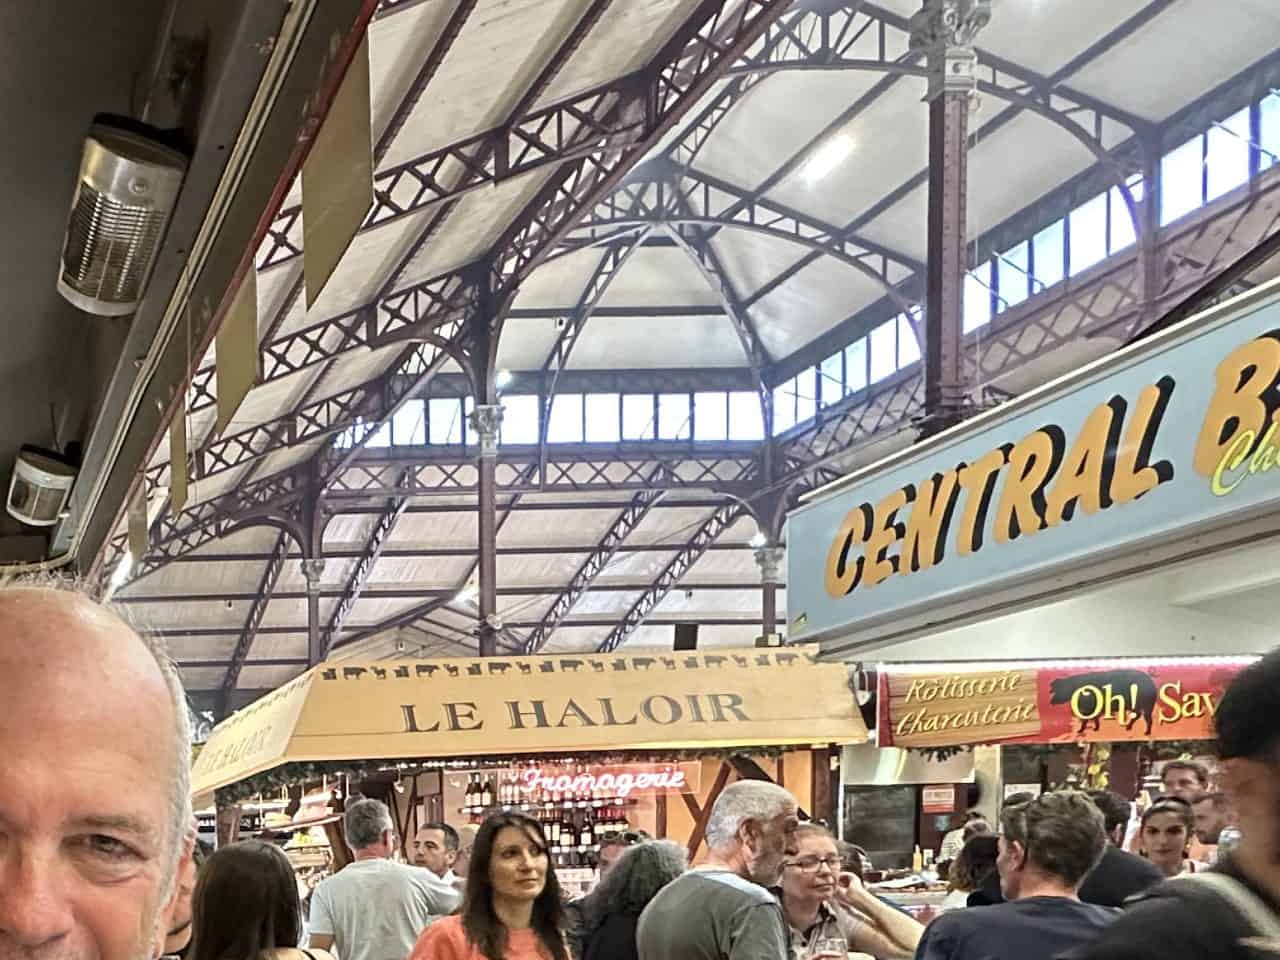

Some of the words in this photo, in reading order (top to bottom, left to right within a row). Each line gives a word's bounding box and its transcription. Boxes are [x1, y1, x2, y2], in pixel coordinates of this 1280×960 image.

[824, 375, 1175, 598] CENTRAL
[1193, 329, 1280, 478] B
[1211, 422, 1280, 496] Ch
[905, 672, 1020, 703] Rôtisserie
[1070, 684, 1138, 725] Oh!
[400, 702, 484, 733] LE
[505, 693, 752, 729] HALOIR
[896, 700, 1035, 735] Charcuterie
[520, 767, 686, 798] Fromagerie
